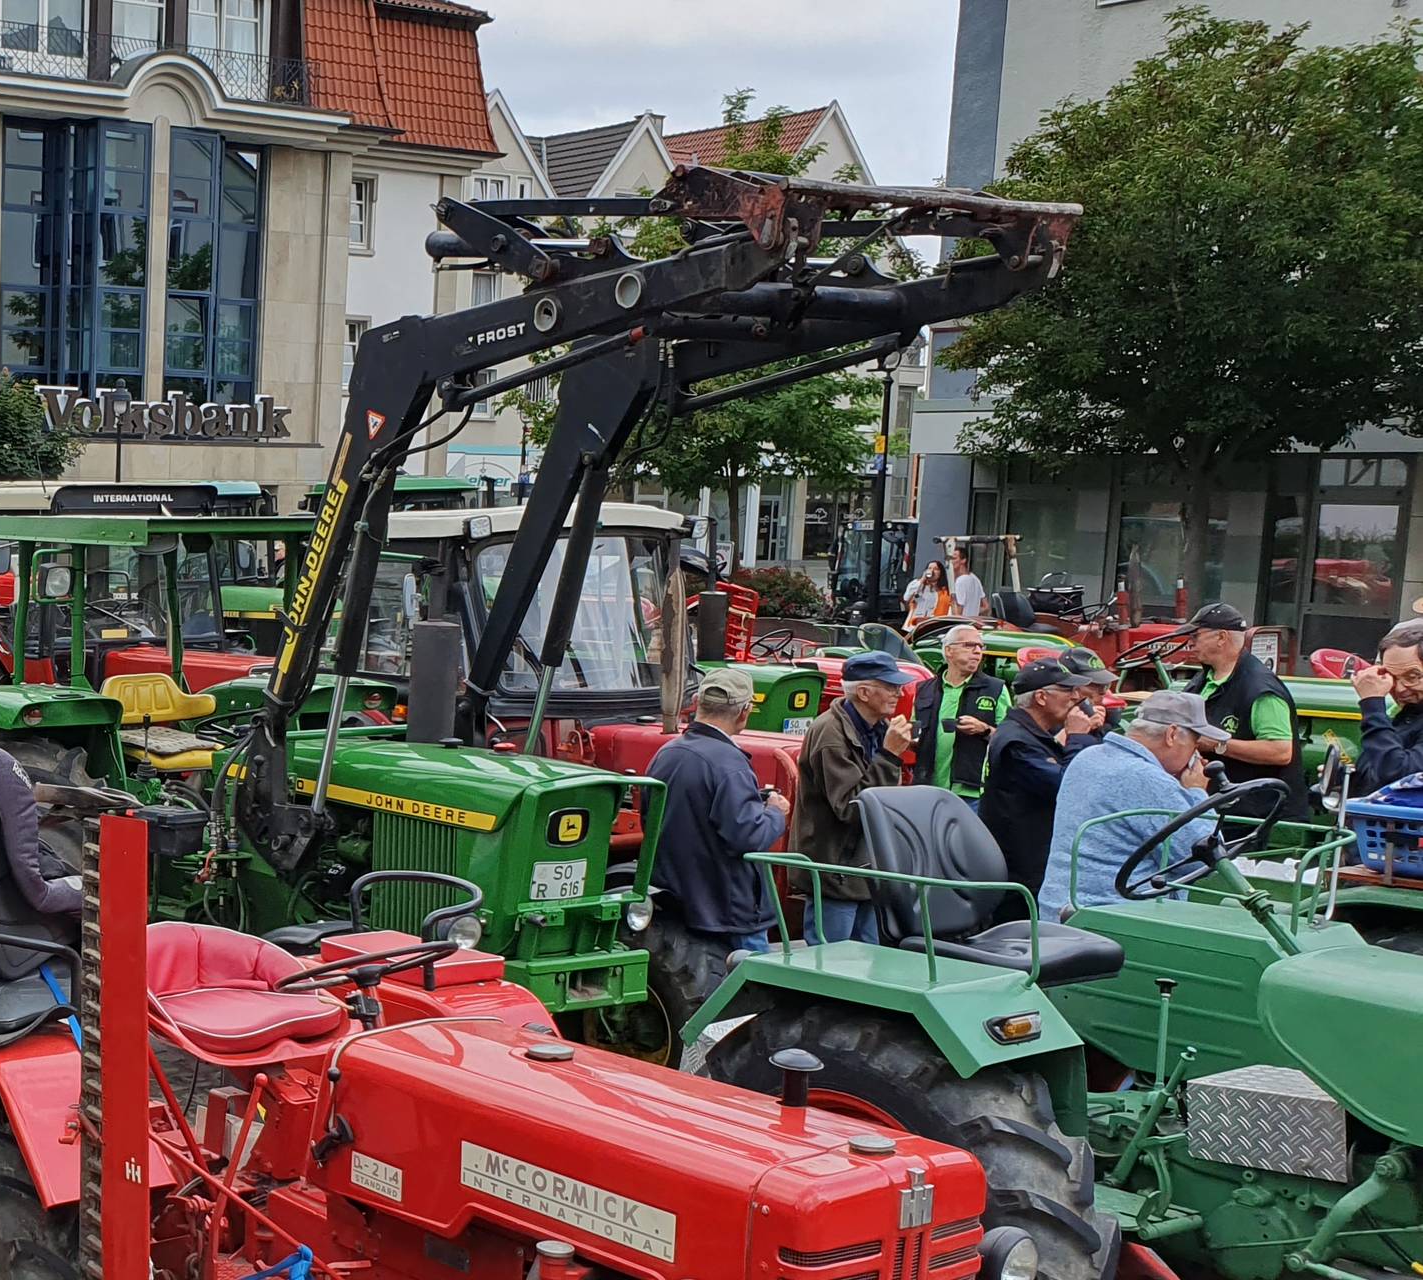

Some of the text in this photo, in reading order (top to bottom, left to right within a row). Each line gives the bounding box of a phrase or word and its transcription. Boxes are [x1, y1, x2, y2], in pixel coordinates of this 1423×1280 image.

[477, 323, 526, 346] FROST
[37, 386, 292, 438] Volksbank
[93, 493, 174, 503] INTERNATIONAL
[284, 575, 313, 643] JOHN
[305, 488, 341, 572] DEERE
[366, 793, 466, 824] JOHN DEERE
[553, 865, 573, 881] SO
[536, 880, 579, 898] R 616
[354, 1174, 398, 1198] STANDARD
[462, 1170, 672, 1259] INTERNATIONAL
